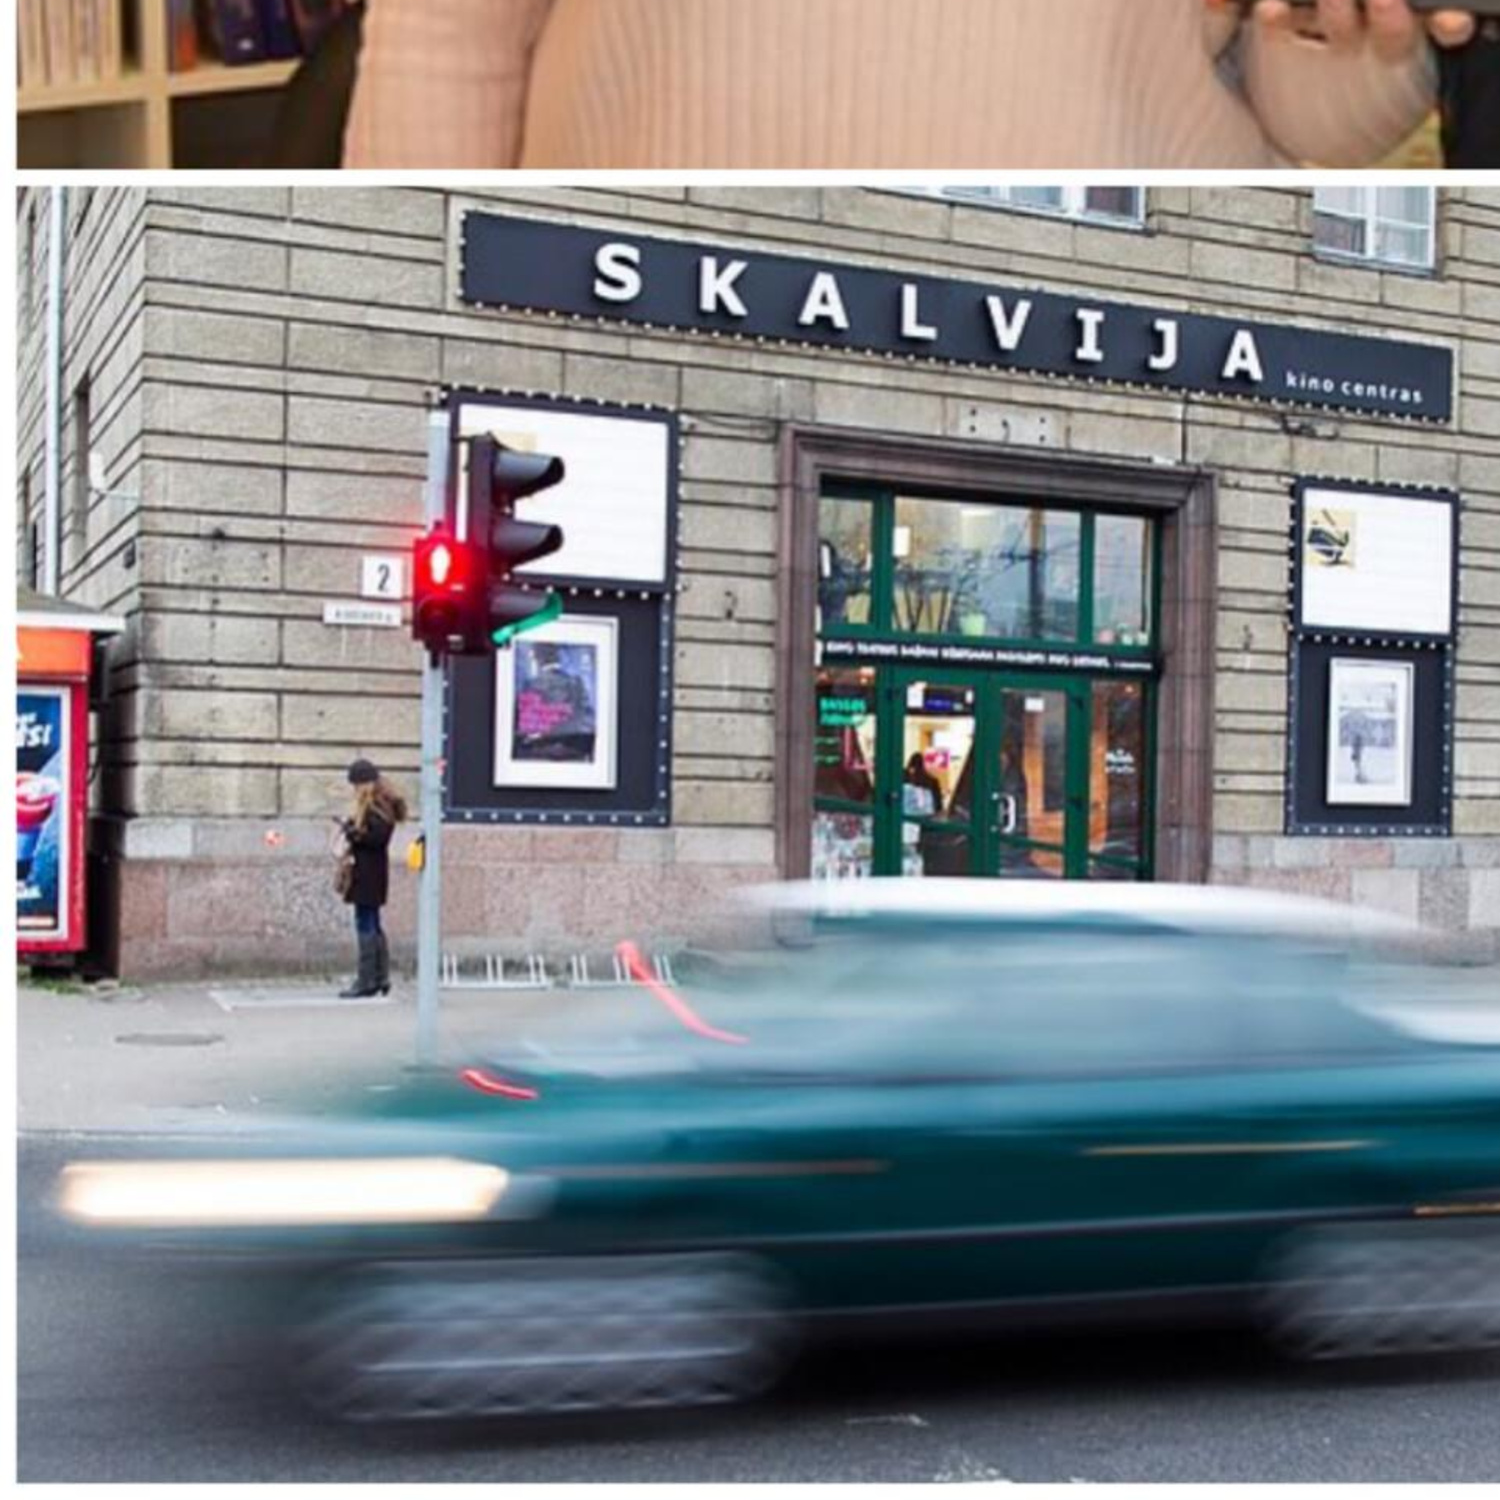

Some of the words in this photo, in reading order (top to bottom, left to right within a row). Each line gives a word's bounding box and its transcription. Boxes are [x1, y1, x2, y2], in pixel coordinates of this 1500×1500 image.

[592, 243, 1265, 382] SKALVIJA
[1286, 371, 1335, 394] kino
[1341, 376, 1424, 404] centras
[377, 563, 391, 592] 2
